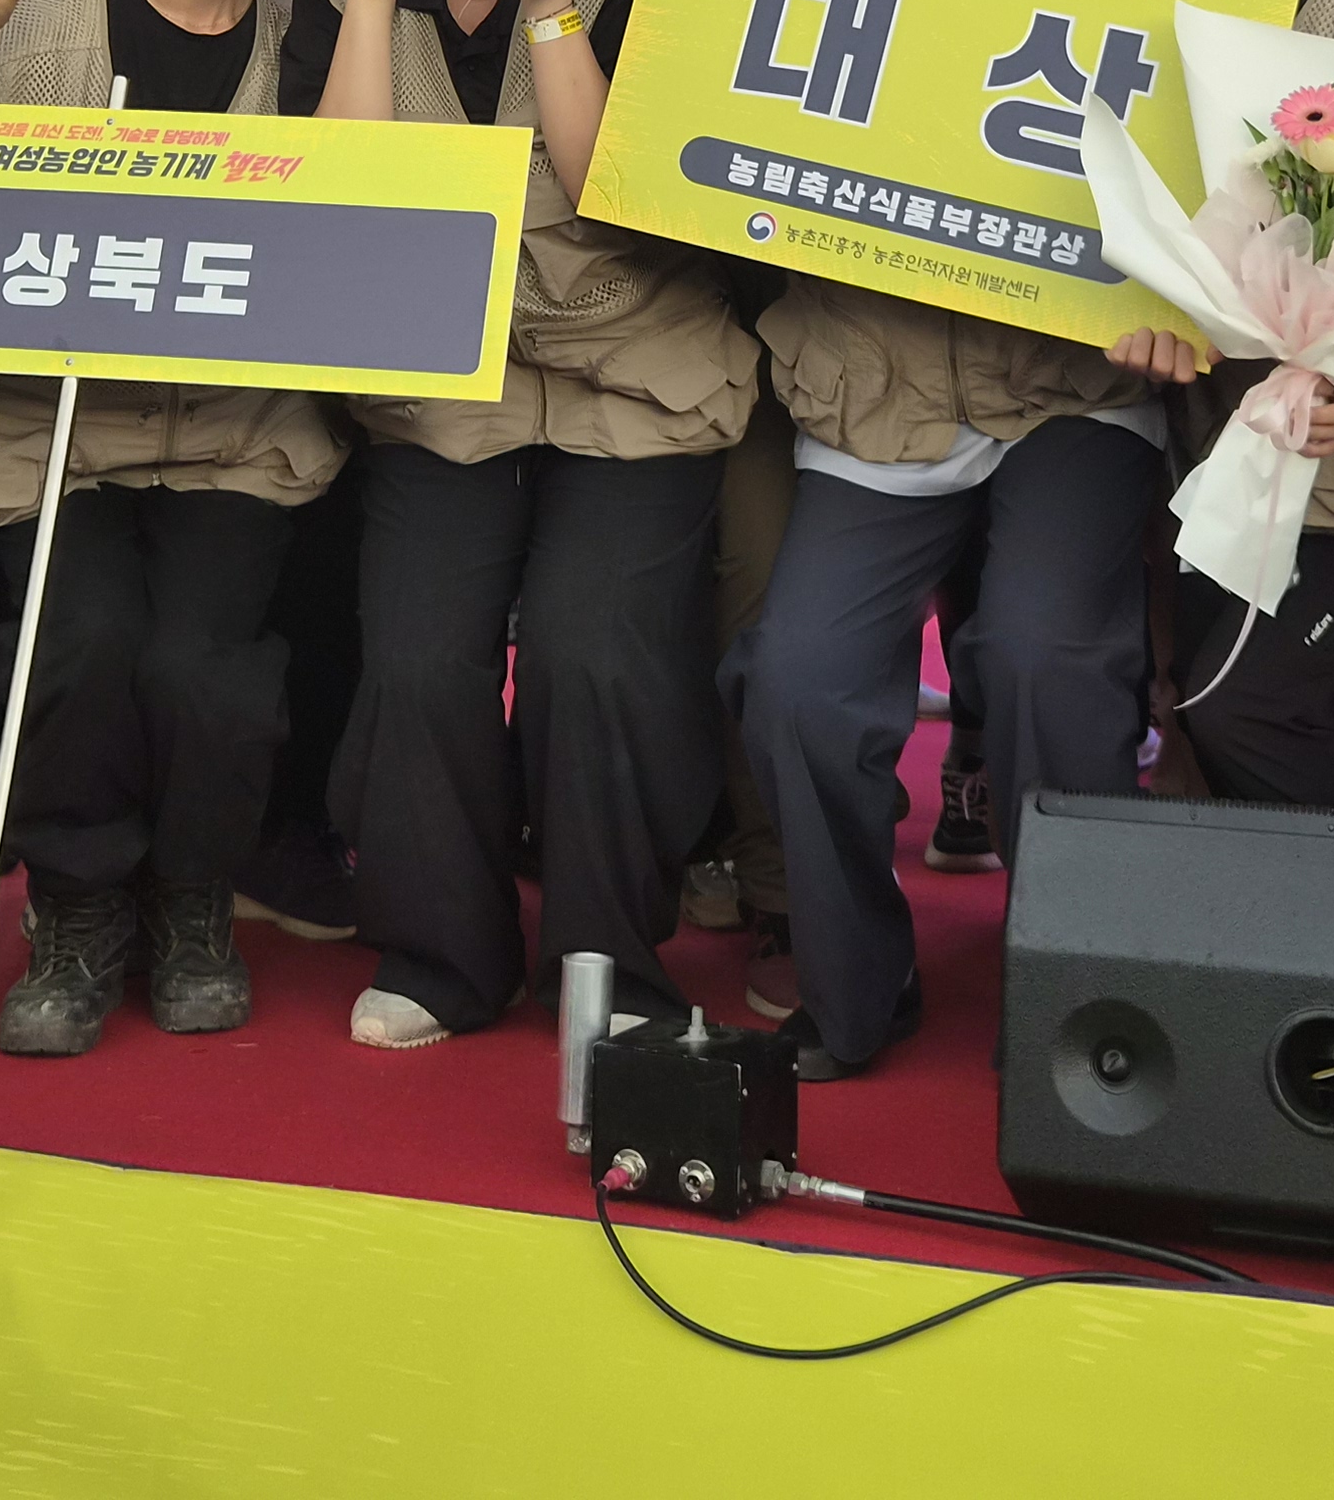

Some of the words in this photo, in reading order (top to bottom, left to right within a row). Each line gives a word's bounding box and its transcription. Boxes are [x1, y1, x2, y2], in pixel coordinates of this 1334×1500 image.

[31, 123, 65, 139] 대신
[110, 126, 160, 143] 기술로
[127, 151, 218, 181] 농기계
[219, 150, 306, 185] 챌린지
[727, 150, 1088, 268] 농림축산식품부장관상
[784, 220, 868, 262] 농촌진흥청
[871, 243, 1042, 305] 농촌인적자원개발센터
